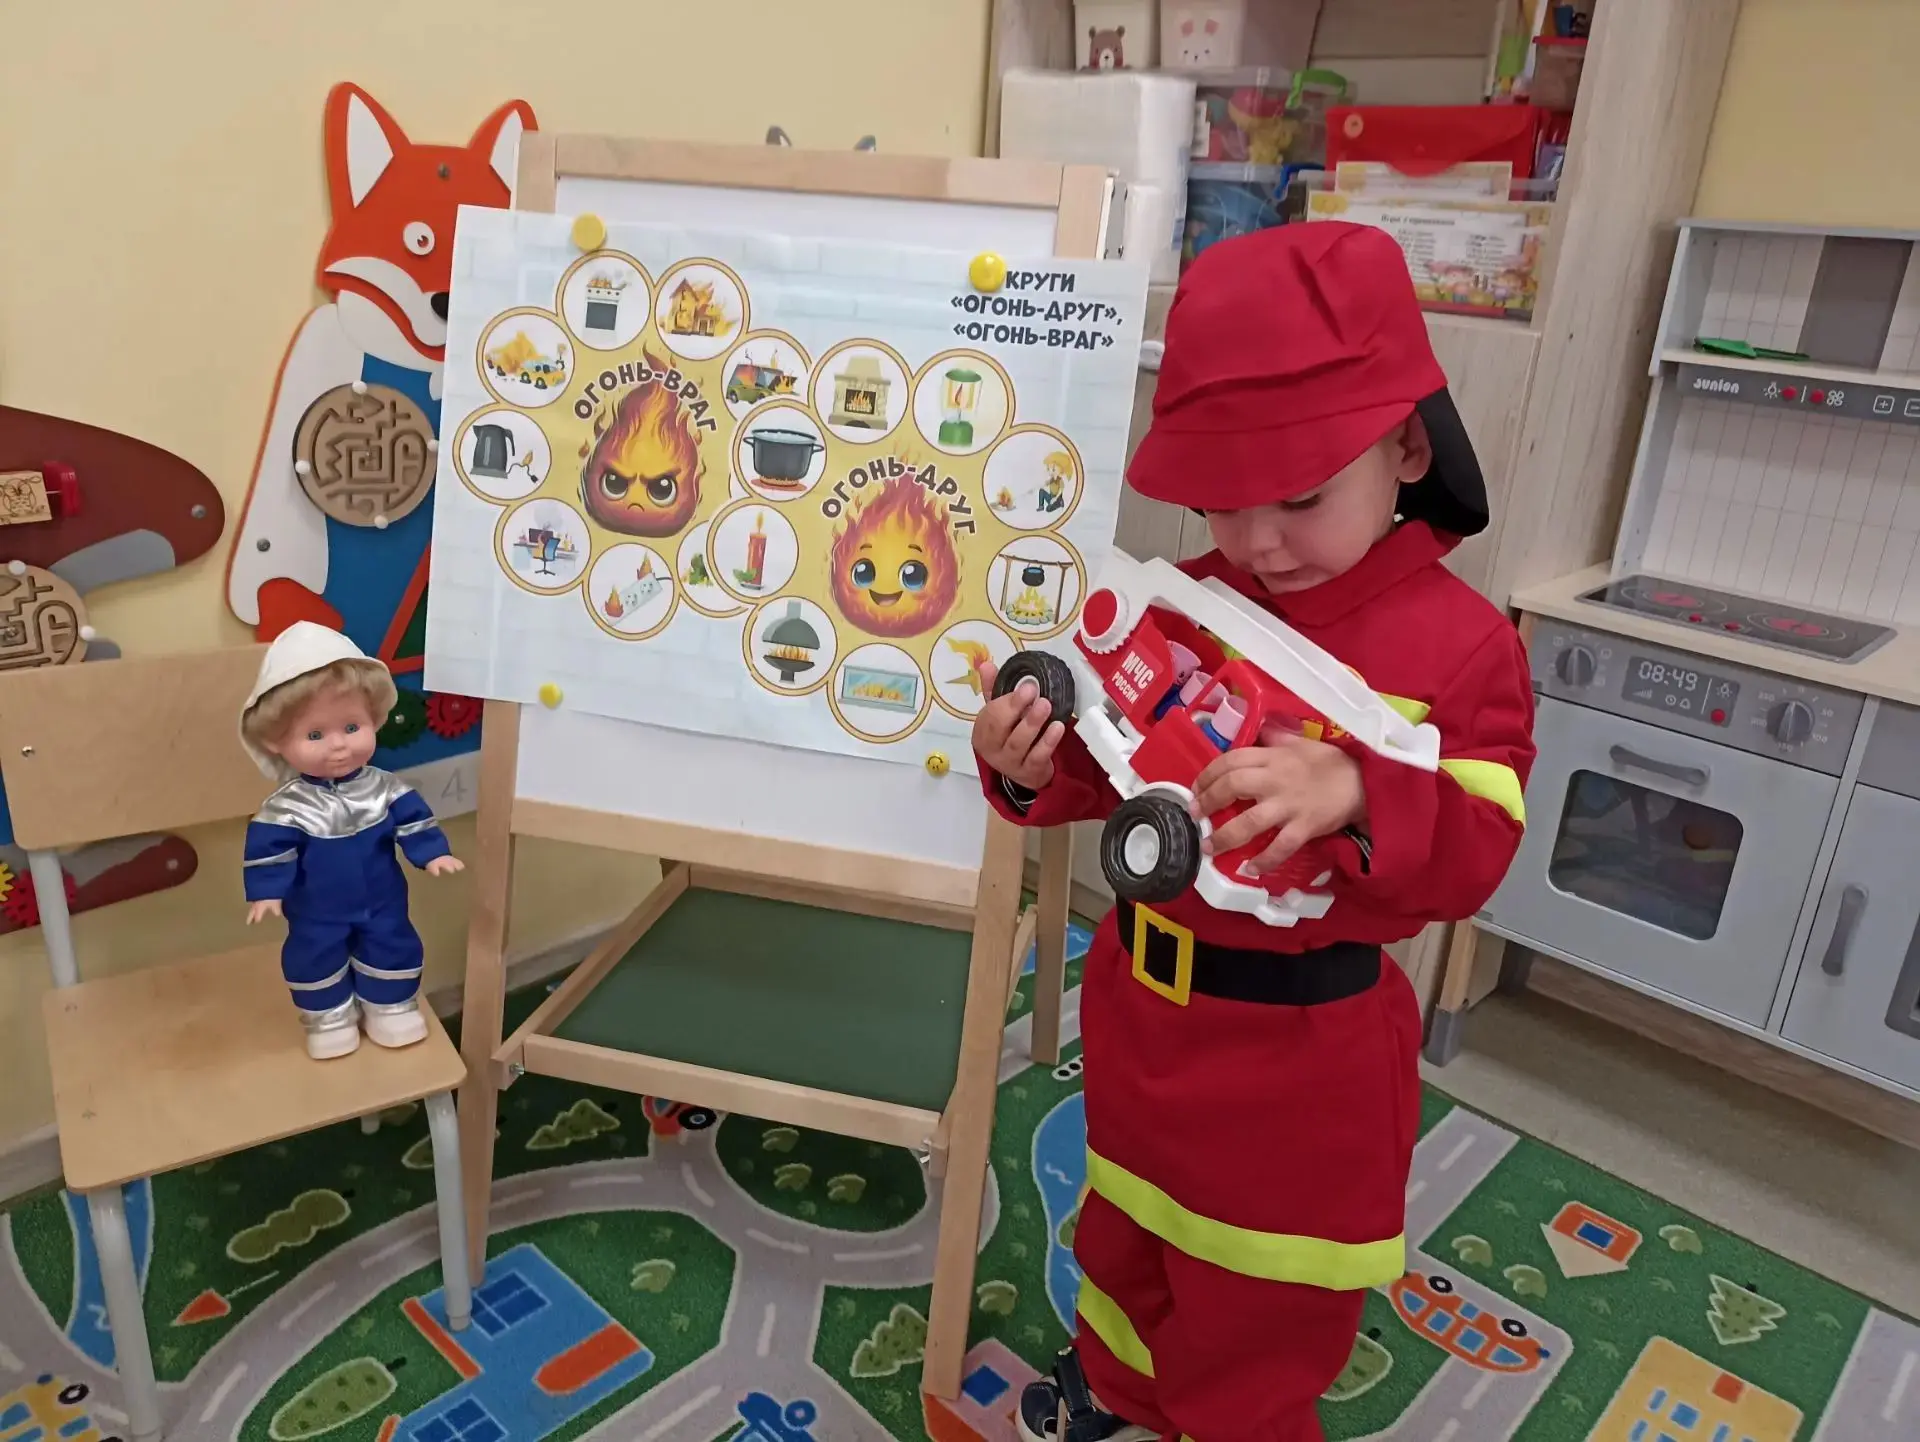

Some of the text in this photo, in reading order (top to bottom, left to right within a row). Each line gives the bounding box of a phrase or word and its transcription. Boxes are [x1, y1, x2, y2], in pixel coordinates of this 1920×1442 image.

[1005, 271, 1075, 293] КРУГИ
[951, 294, 1123, 325] «ОГОНЬ-ДРУГ»,
[953, 322, 1115, 350] «ОГОНЬ-ВРАГ»
[574, 361, 717, 431] ОГОНЬ-ВРАГ
[822, 456, 976, 534] ОГОНЬ-ДРУГ
[1121, 650, 1155, 689] МЧС
[1638, 661, 1699, 691] 08:49
[1111, 671, 1139, 705] РОССИИ
[441, 767, 468, 803] 4
